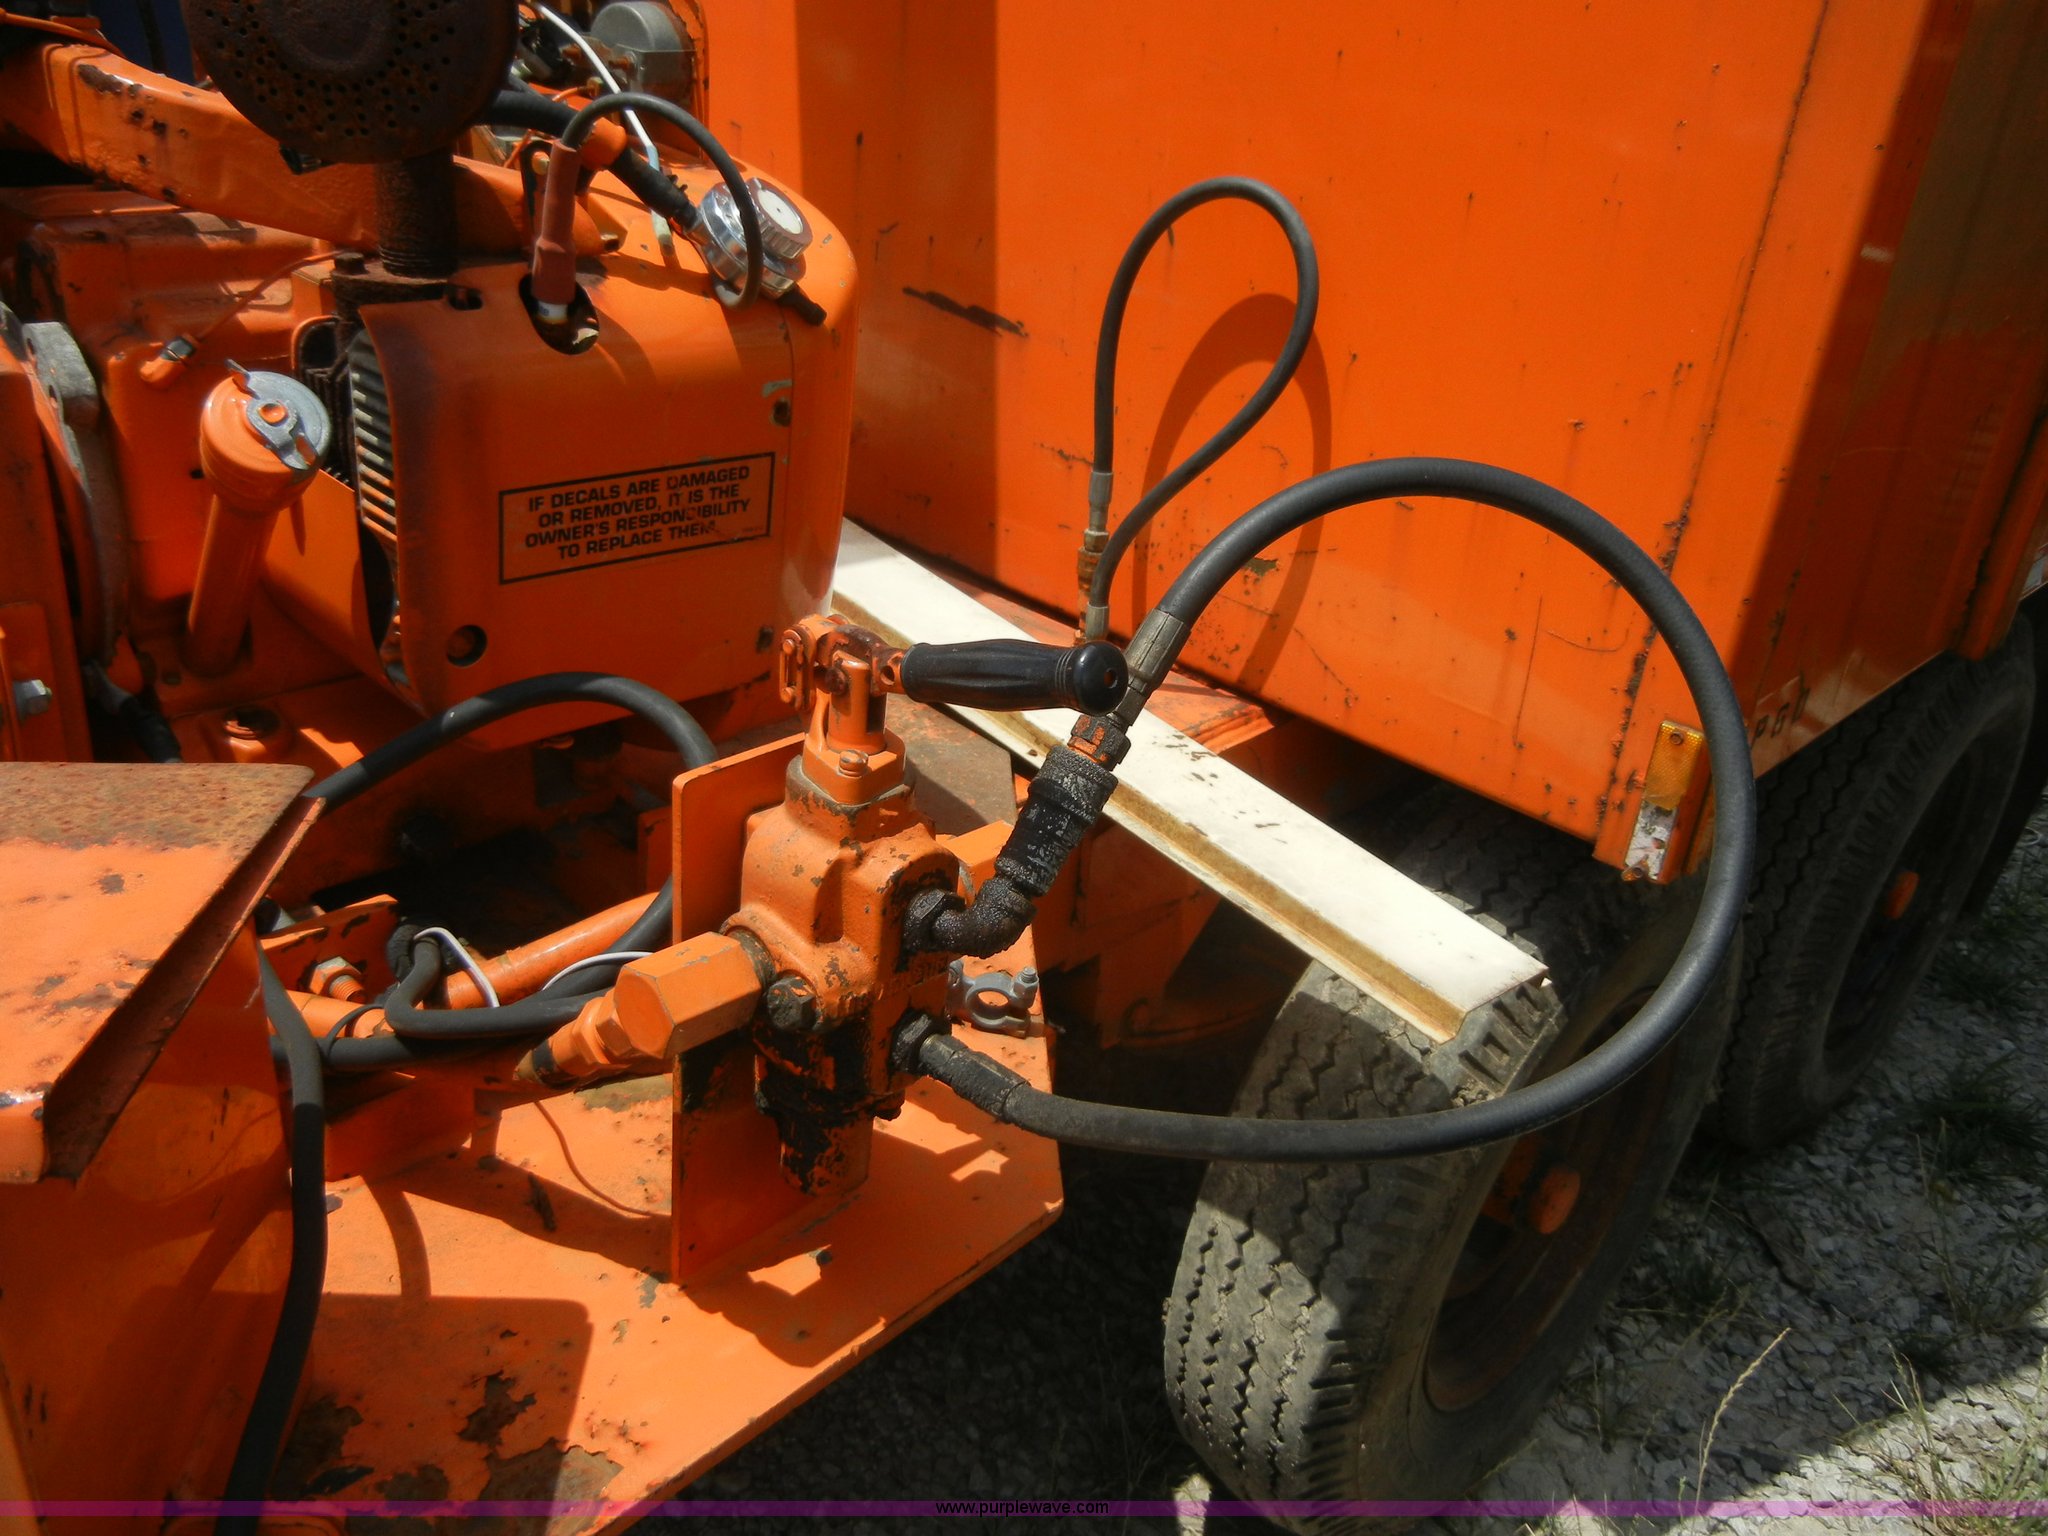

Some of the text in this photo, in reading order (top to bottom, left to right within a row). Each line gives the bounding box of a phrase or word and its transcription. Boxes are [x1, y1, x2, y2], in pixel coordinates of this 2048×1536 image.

[529, 465, 750, 512] IF DECALS ARE DAMAGED
[538, 484, 740, 528] OR REMOVED, IT IS THE
[525, 522, 610, 548] OWNER'S
[557, 543, 580, 560] TO
[586, 529, 662, 554] REPLACE
